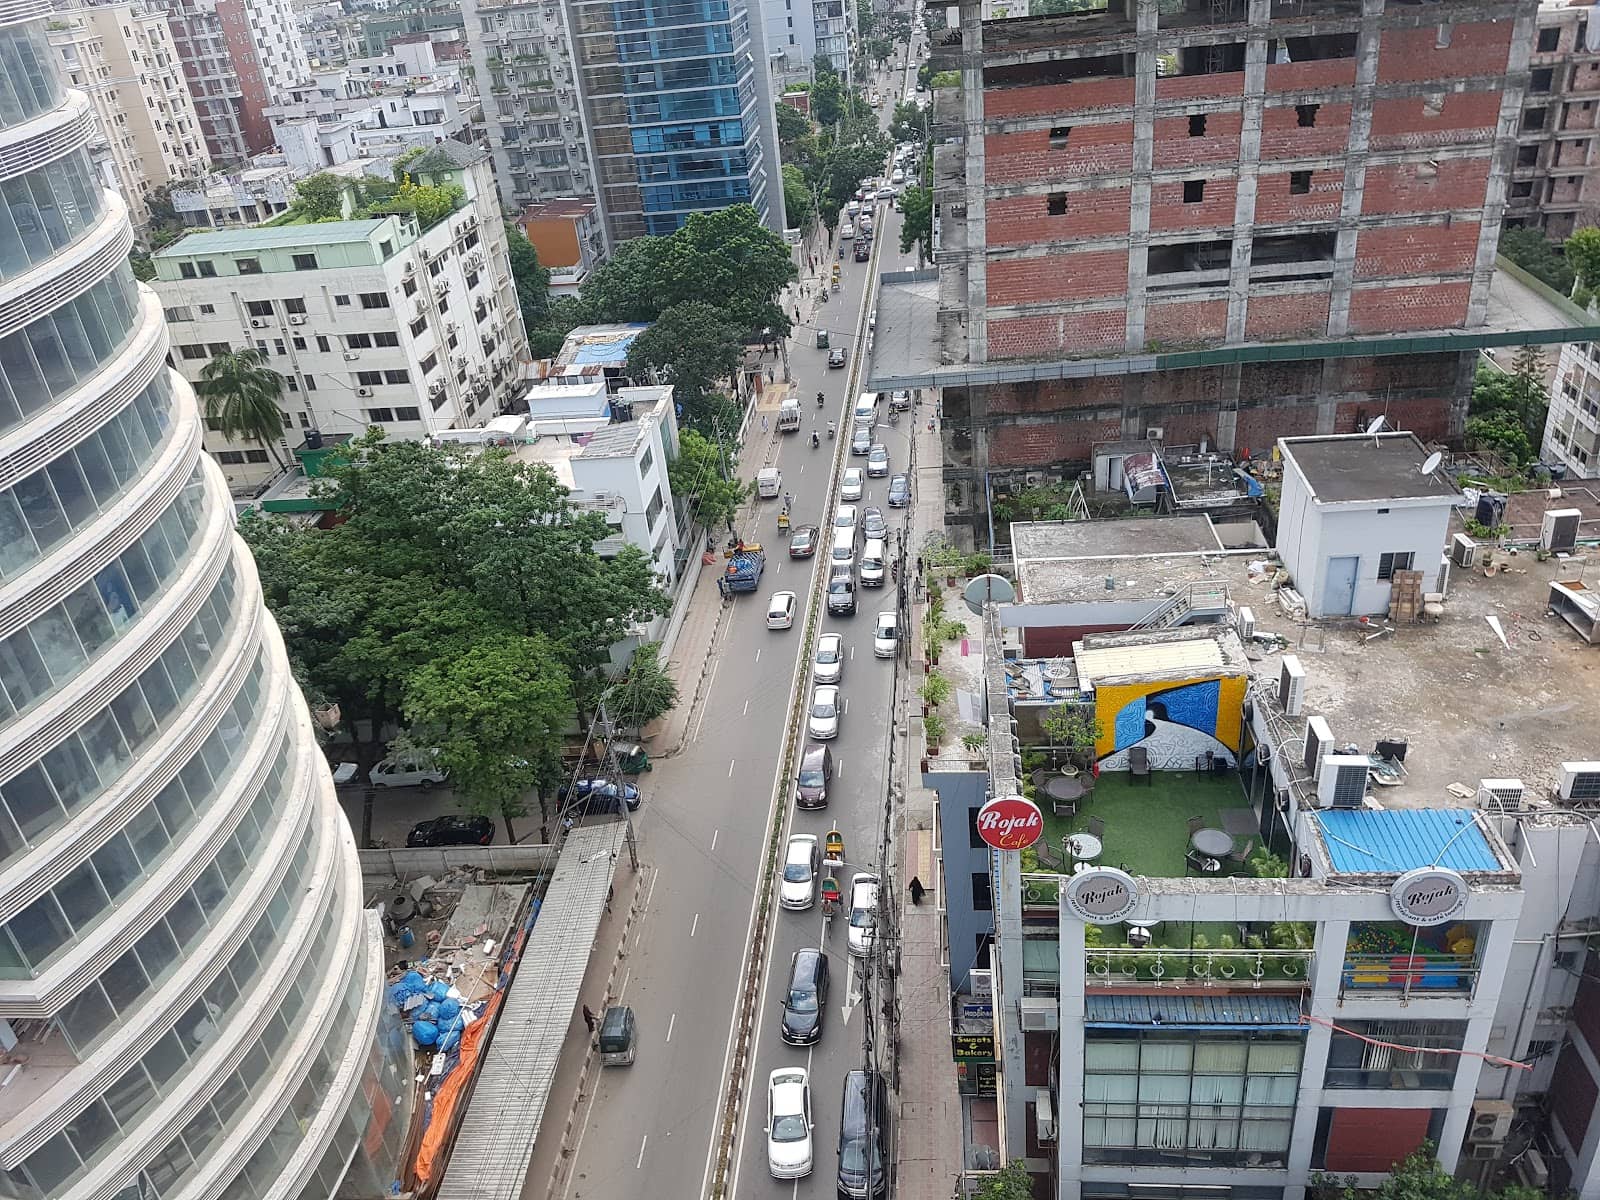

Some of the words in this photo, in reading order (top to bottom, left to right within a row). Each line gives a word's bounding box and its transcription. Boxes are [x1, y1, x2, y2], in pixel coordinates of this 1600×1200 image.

[980, 811, 1039, 836] Rojak
[999, 833, 1029, 848] Cafe
[1081, 884, 1123, 904] Rojak
[1408, 885, 1453, 905] Rojak
